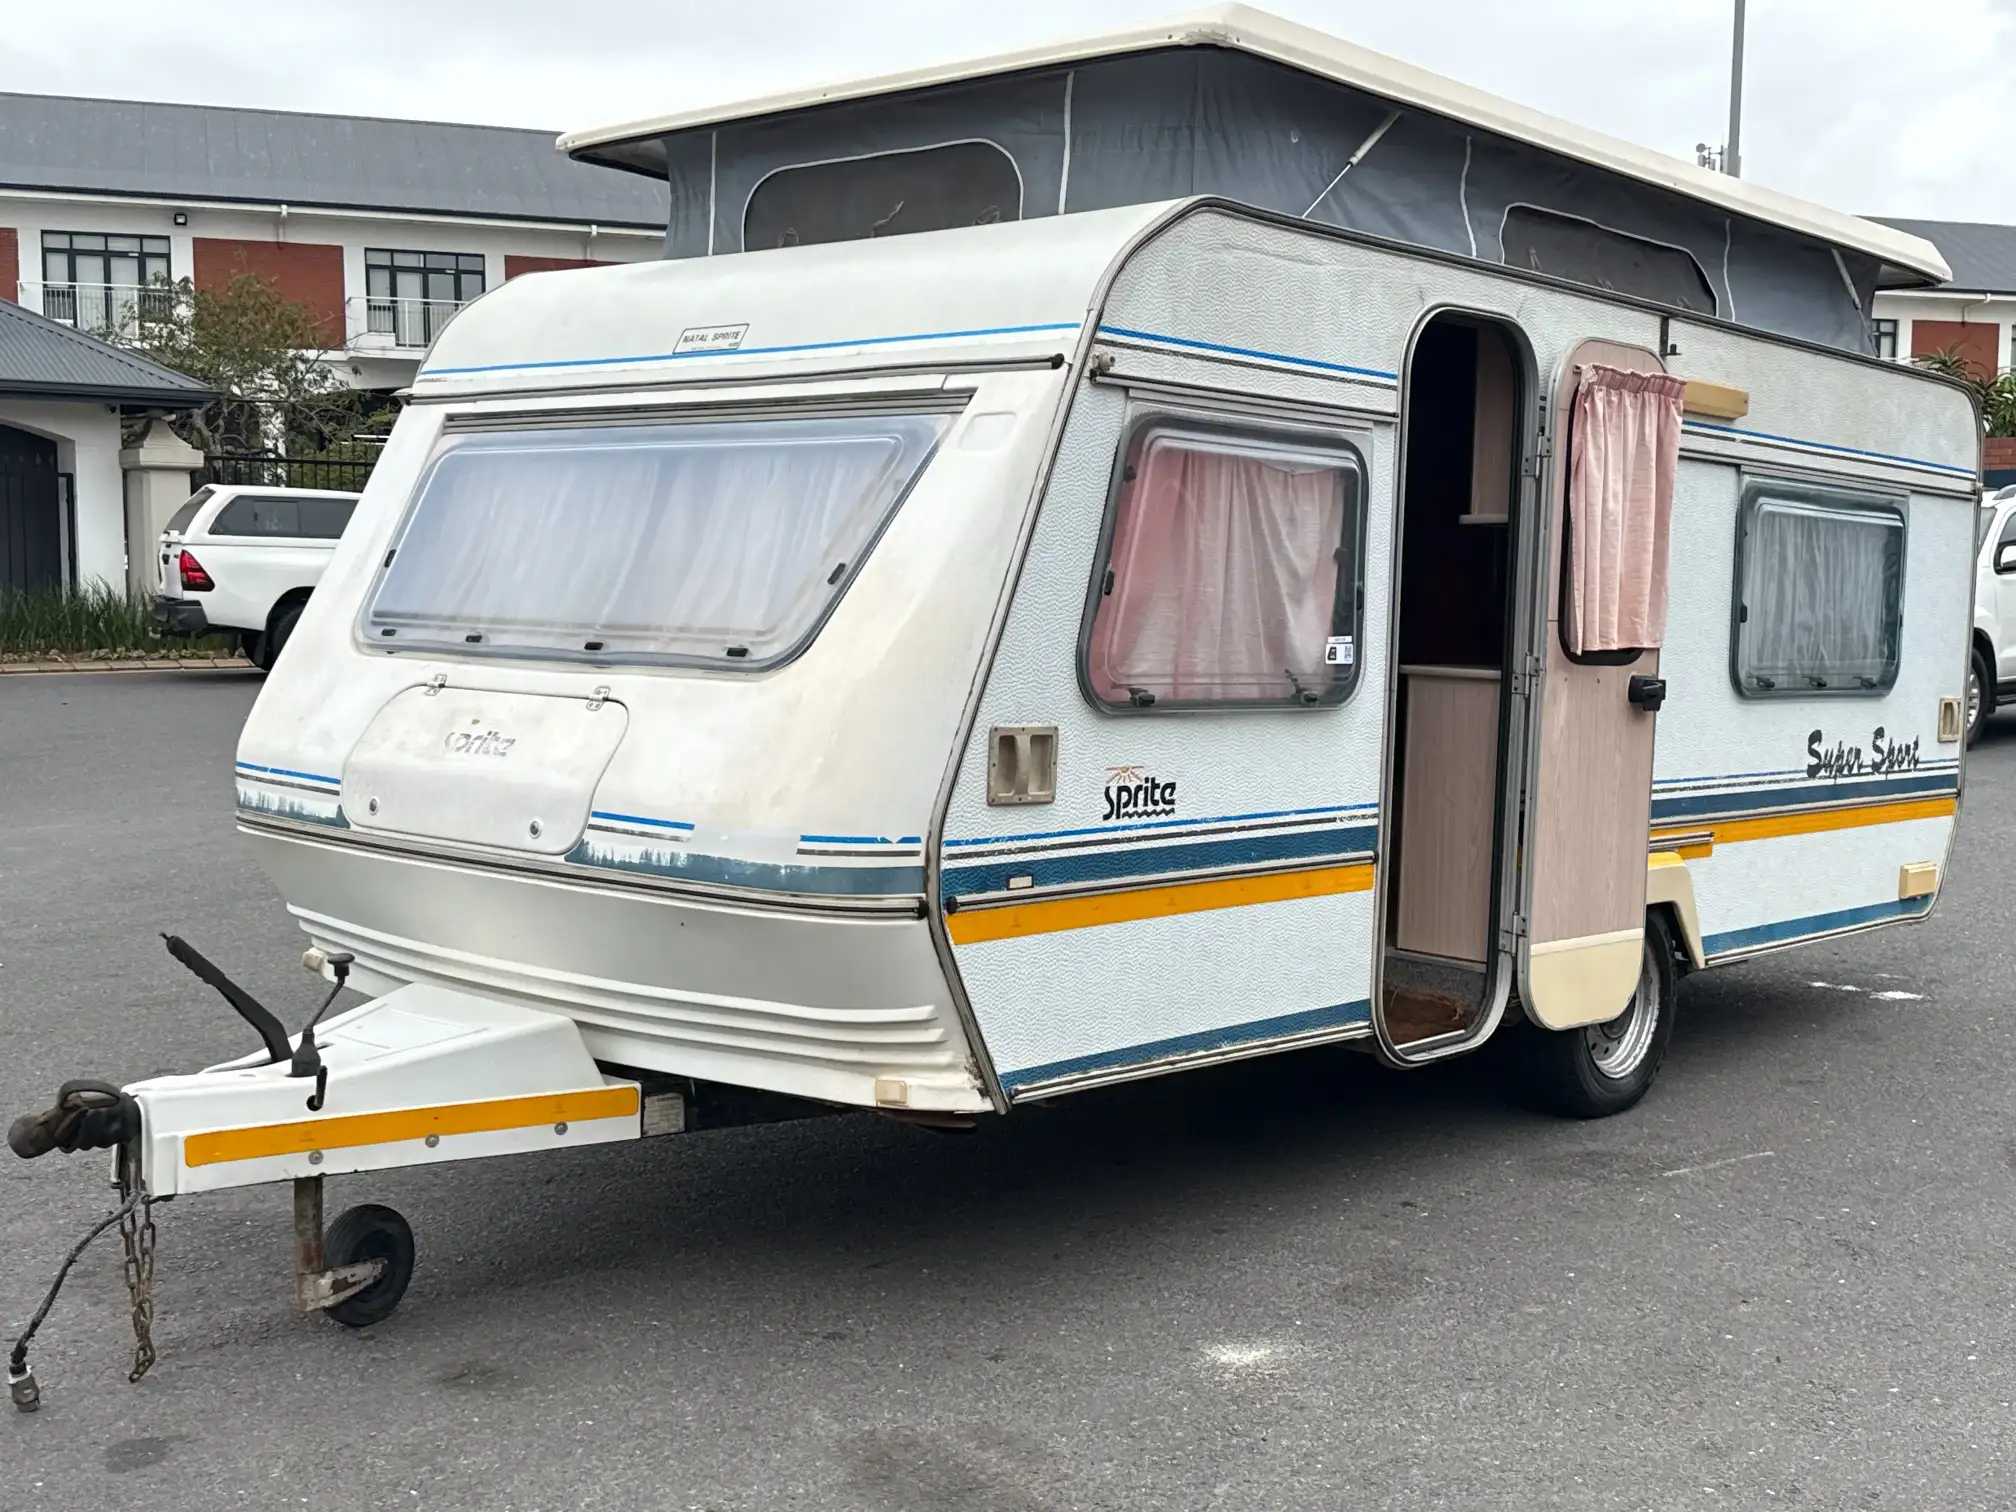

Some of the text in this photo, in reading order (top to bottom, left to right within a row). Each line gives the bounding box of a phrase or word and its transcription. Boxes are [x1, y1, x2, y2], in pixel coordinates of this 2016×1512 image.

[682, 331, 741, 343] NATAL SPRITE
[1806, 726, 1920, 784] Super Sport
[1102, 777, 1176, 821] Sprite
